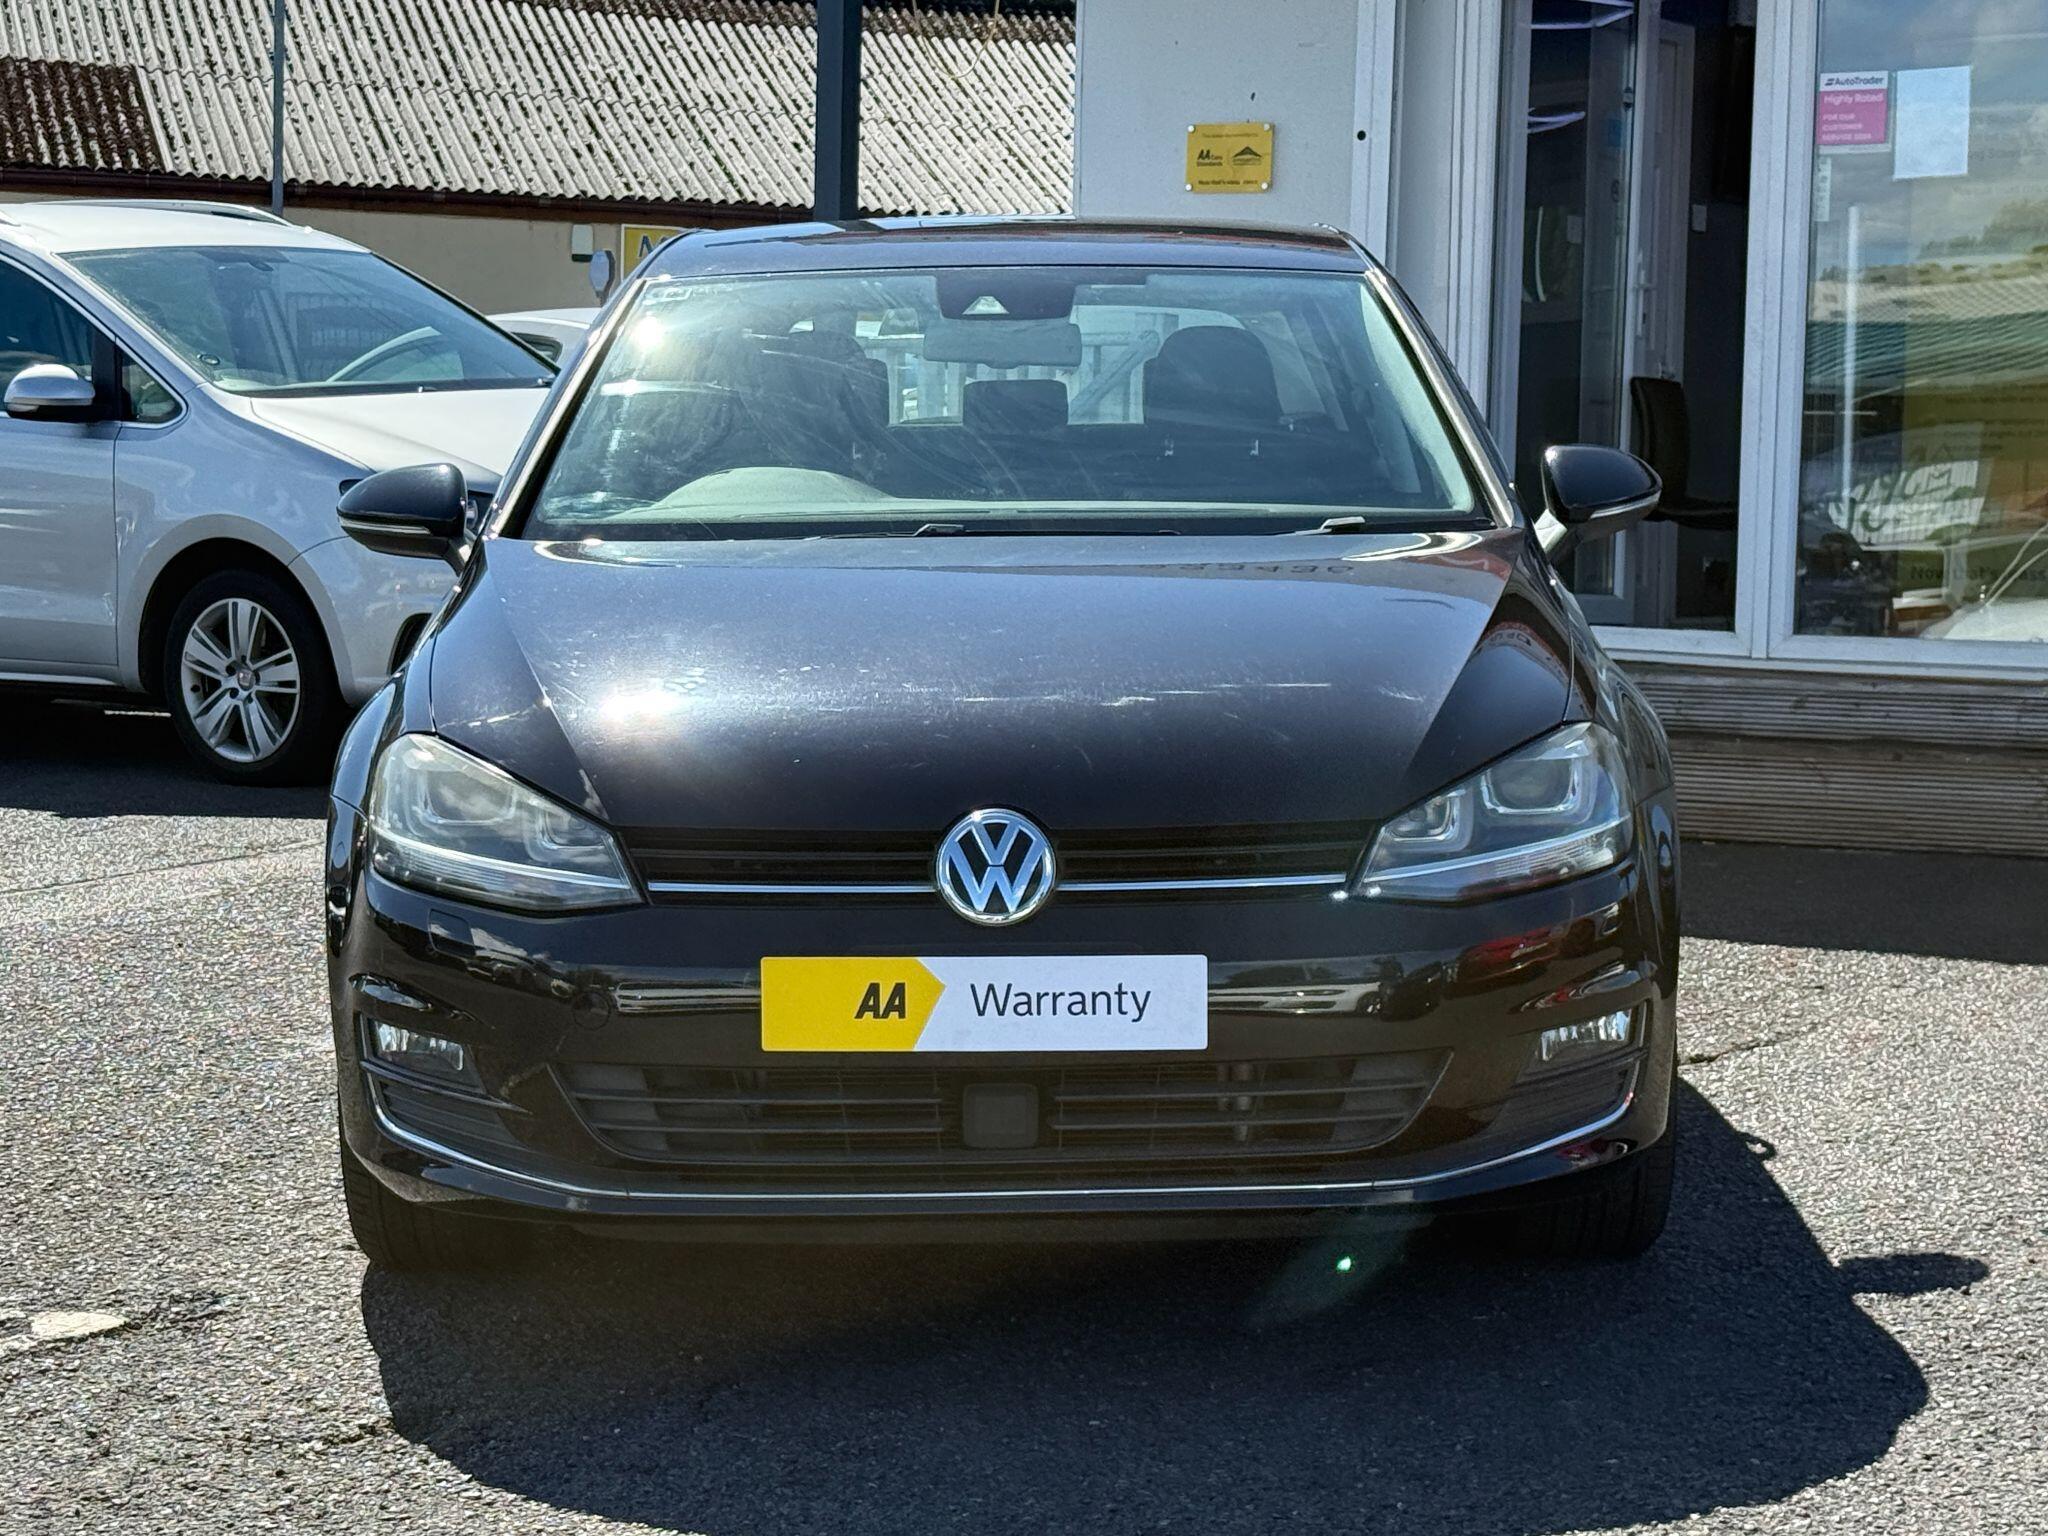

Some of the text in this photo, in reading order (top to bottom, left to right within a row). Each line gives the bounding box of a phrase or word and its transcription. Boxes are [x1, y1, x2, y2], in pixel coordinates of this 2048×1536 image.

[1835, 76, 1884, 86] AutoTrader
[1823, 93, 1884, 105] Highly Rated
[854, 982, 1152, 1023] AA Warranty
